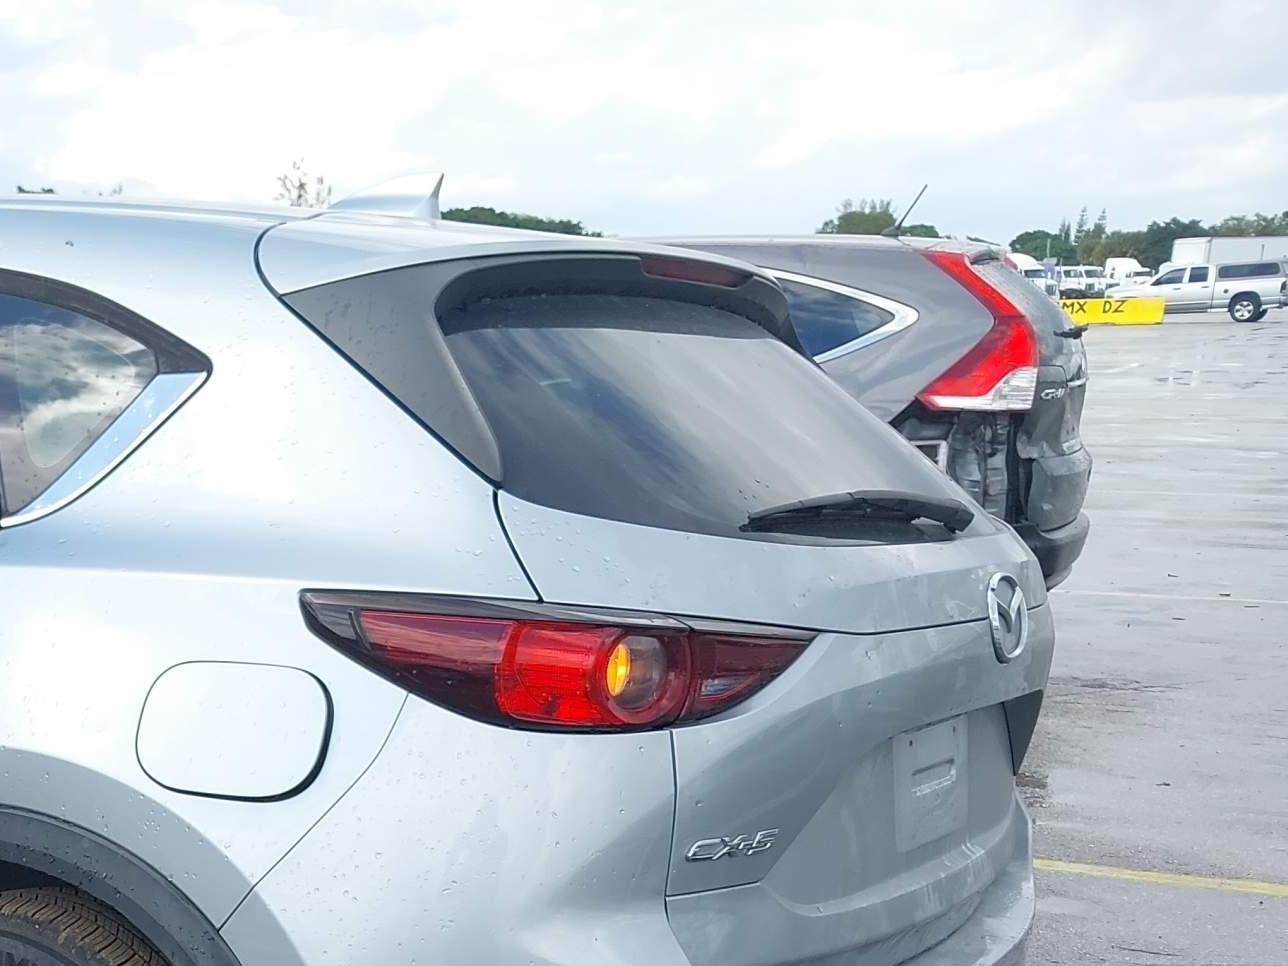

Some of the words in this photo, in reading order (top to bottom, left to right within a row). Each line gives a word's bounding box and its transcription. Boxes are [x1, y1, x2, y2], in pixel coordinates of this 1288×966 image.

[1057, 300, 1087, 314] MX
[1102, 298, 1129, 314] DZ
[685, 827, 780, 861] CX-5
